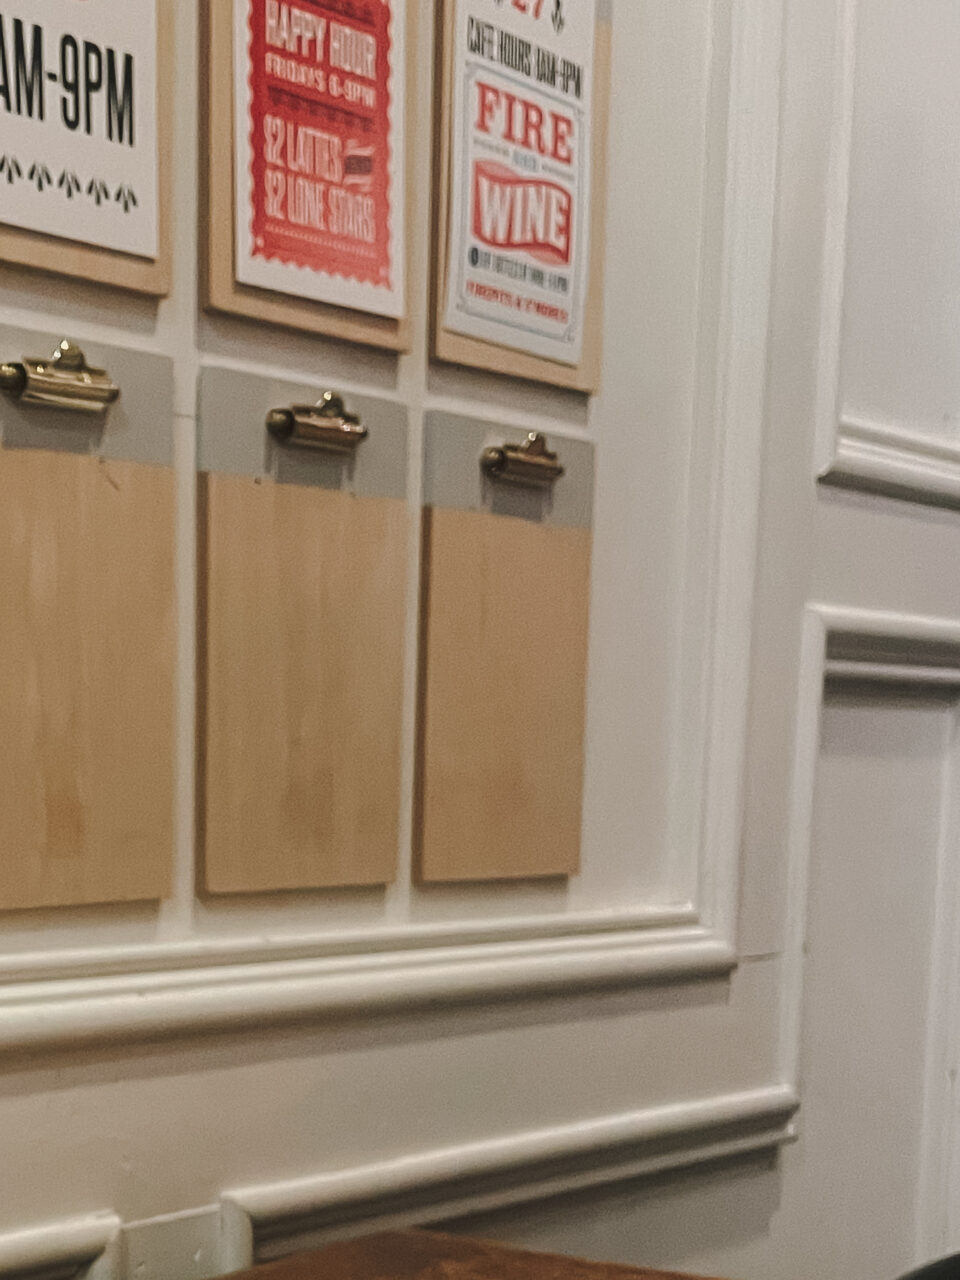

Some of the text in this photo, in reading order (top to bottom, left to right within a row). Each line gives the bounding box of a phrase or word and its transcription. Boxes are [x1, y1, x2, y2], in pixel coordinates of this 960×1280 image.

[265, 0, 377, 81] HAPPY HOUR
[265, 52, 326, 93] FRIDAYS
[499, 30, 531, 77] HOURS
[286, 121, 342, 183] LATTES
[476, 81, 574, 165] FIRE
[287, 174, 327, 231] LONE
[328, 186, 376, 243] STARS
[478, 175, 569, 249] WINE
